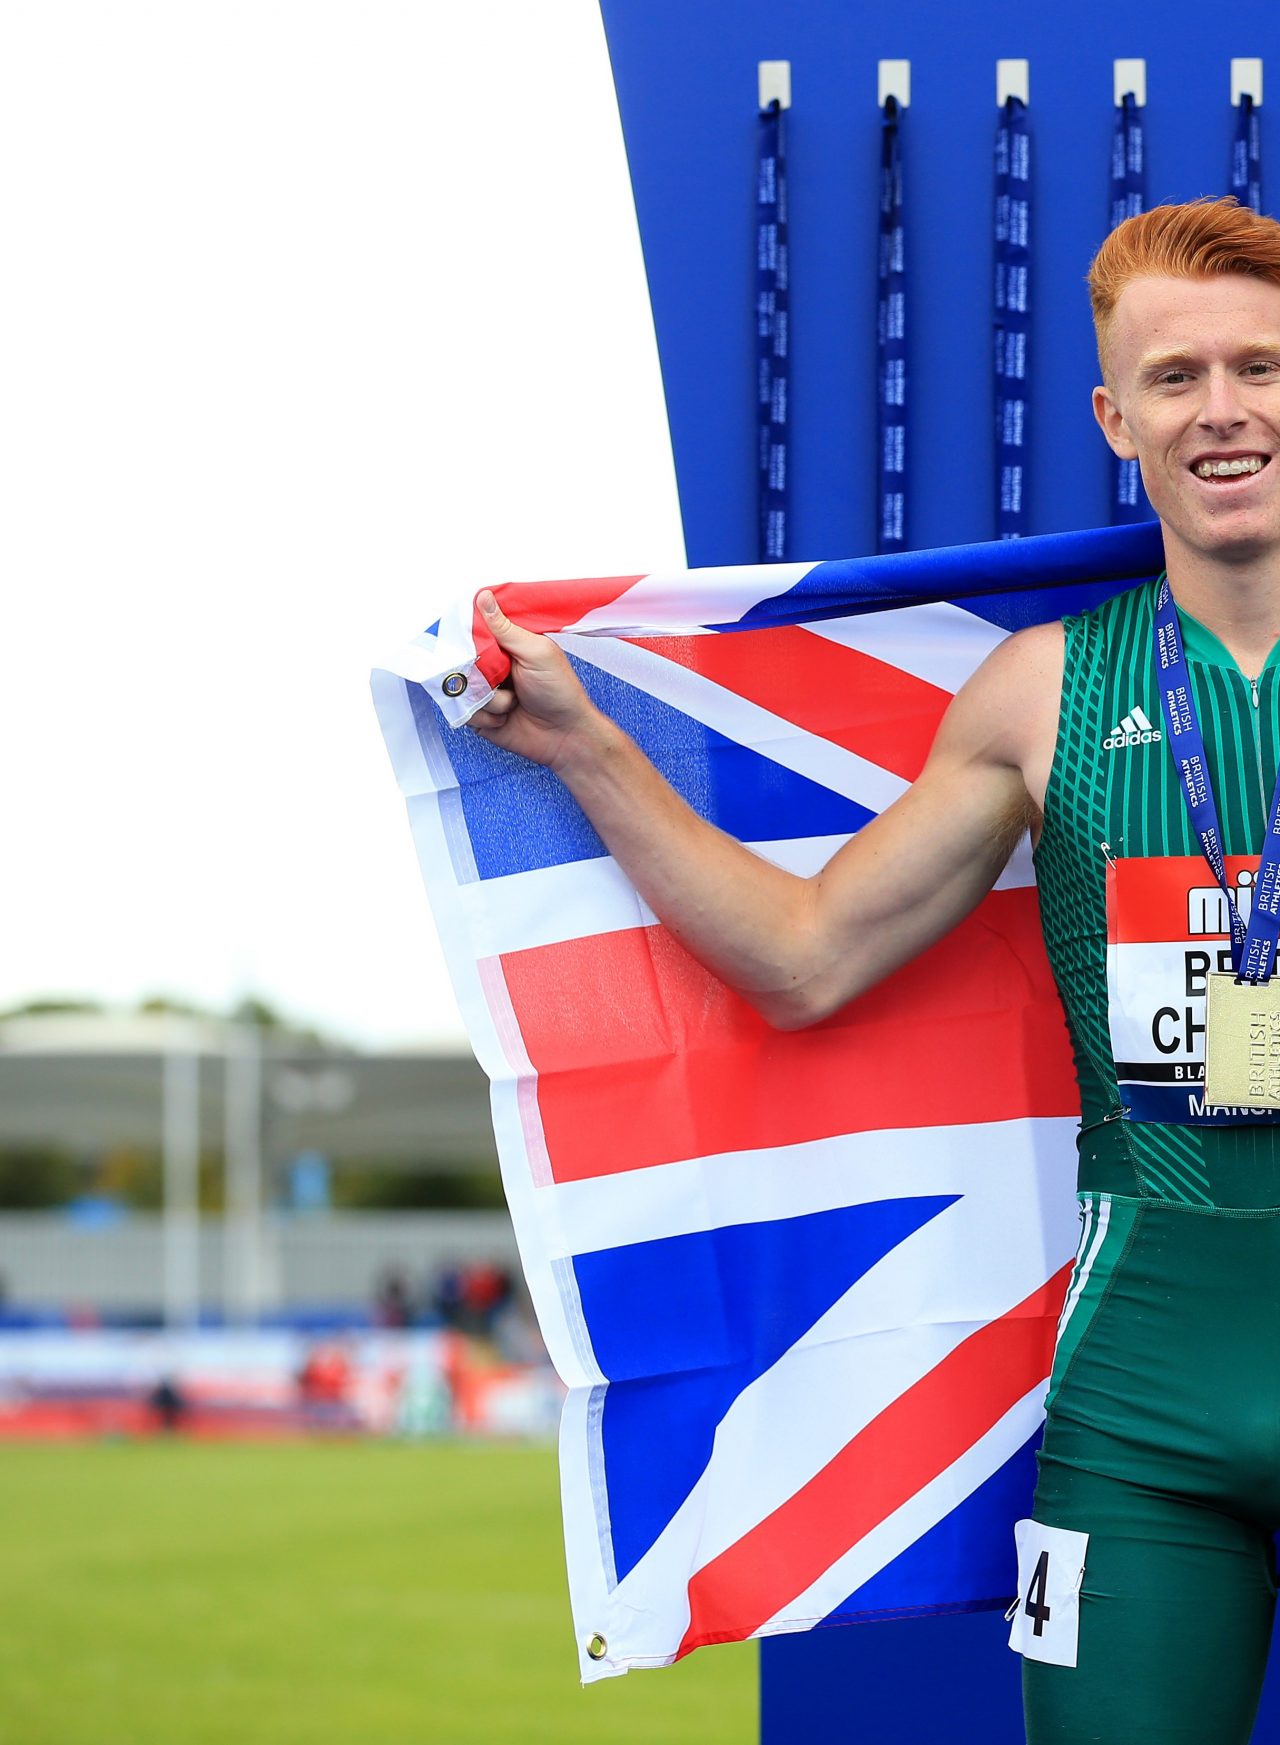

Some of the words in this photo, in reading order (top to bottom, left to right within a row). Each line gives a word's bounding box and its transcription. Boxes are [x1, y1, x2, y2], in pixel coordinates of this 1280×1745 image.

[1157, 628, 1169, 669] ATHLETICS
[1165, 622, 1179, 665] BRITISH
[1166, 690, 1182, 736] ATHLETICS
[1175, 686, 1193, 732] BRITISH
[1103, 730, 1162, 750] adidas
[1181, 759, 1199, 808] ATHLETICS
[1190, 755, 1208, 803] BRITISH
[1258, 862, 1277, 911] BRITISH
[1245, 938, 1262, 980] RITISH
[1257, 940, 1271, 980] HLETICS
[1174, 1065, 1205, 1080] BLA
[1249, 1012, 1266, 1097] BRITISH
[1268, 1011, 1280, 1101] ATHLETICS
[1025, 1550, 1050, 1637] 4
